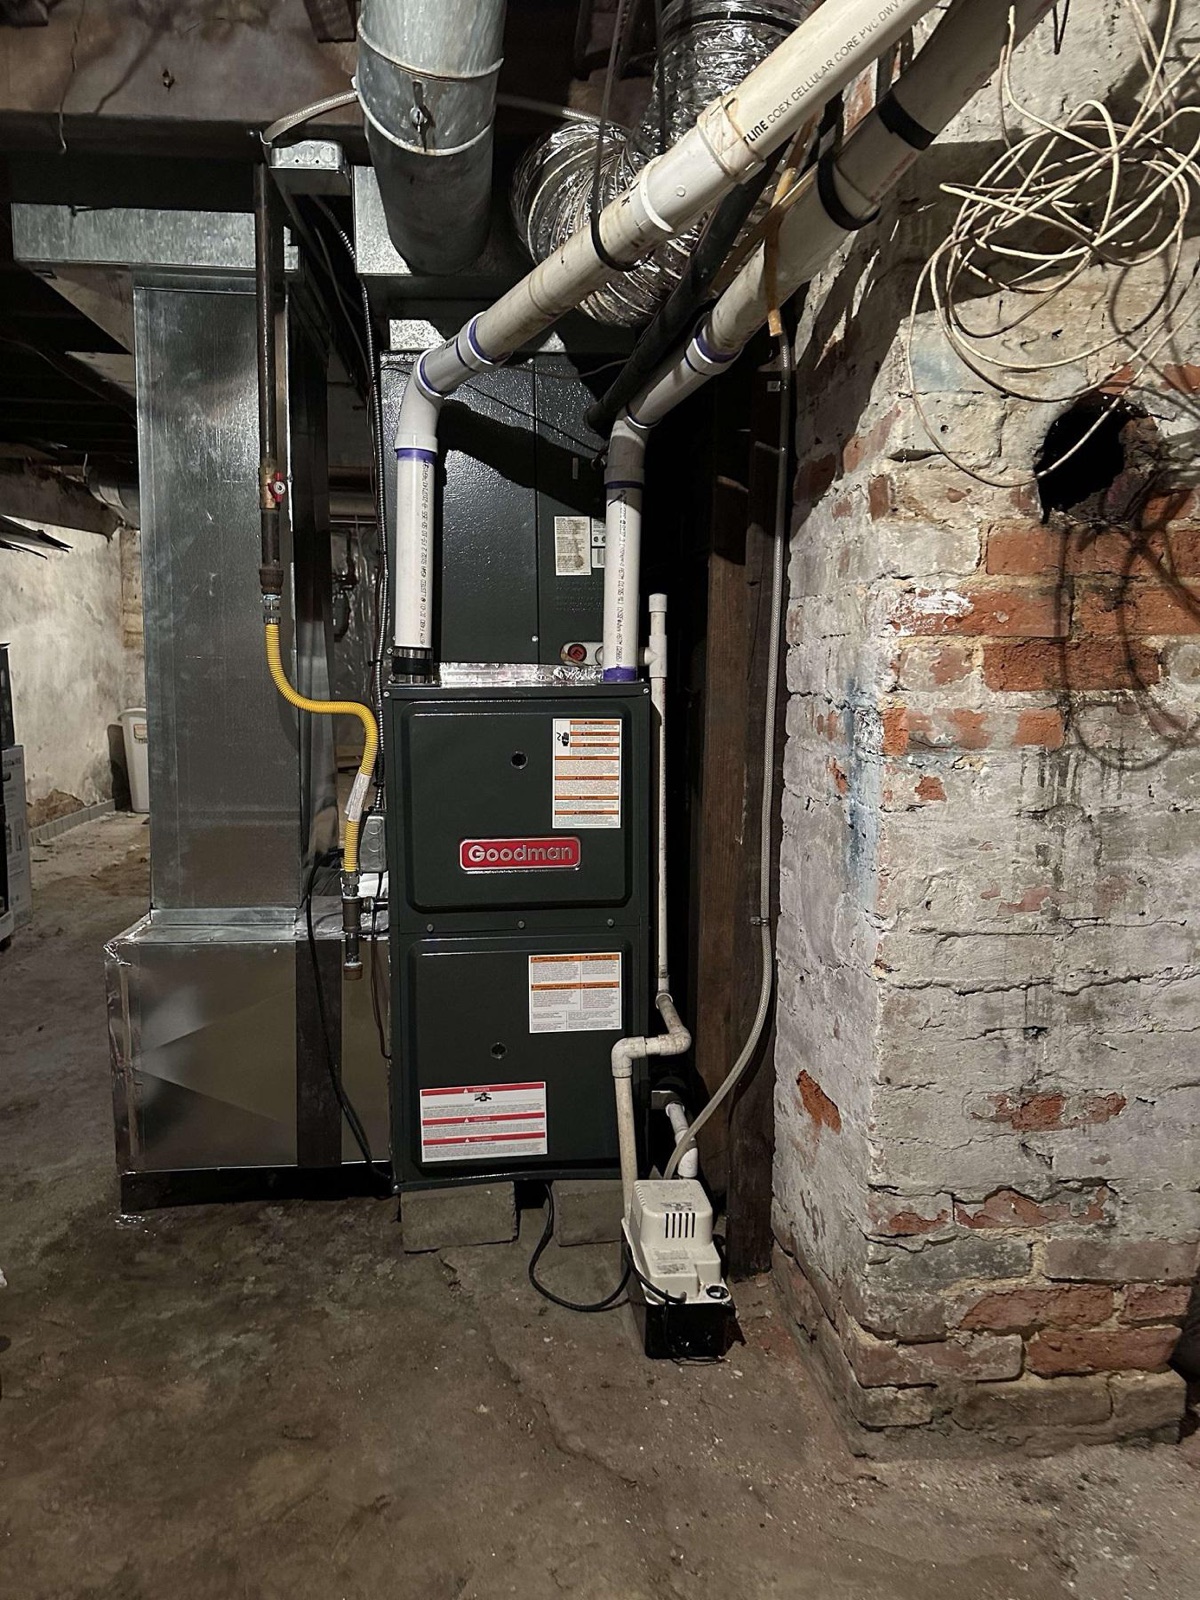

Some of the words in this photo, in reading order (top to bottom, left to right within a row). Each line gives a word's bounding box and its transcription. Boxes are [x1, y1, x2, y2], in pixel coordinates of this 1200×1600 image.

[767, 99, 792, 123] COEX
[791, 59, 835, 101] CELLULAR
[834, 35, 861, 62] CORE
[468, 844, 573, 863] Goodman
